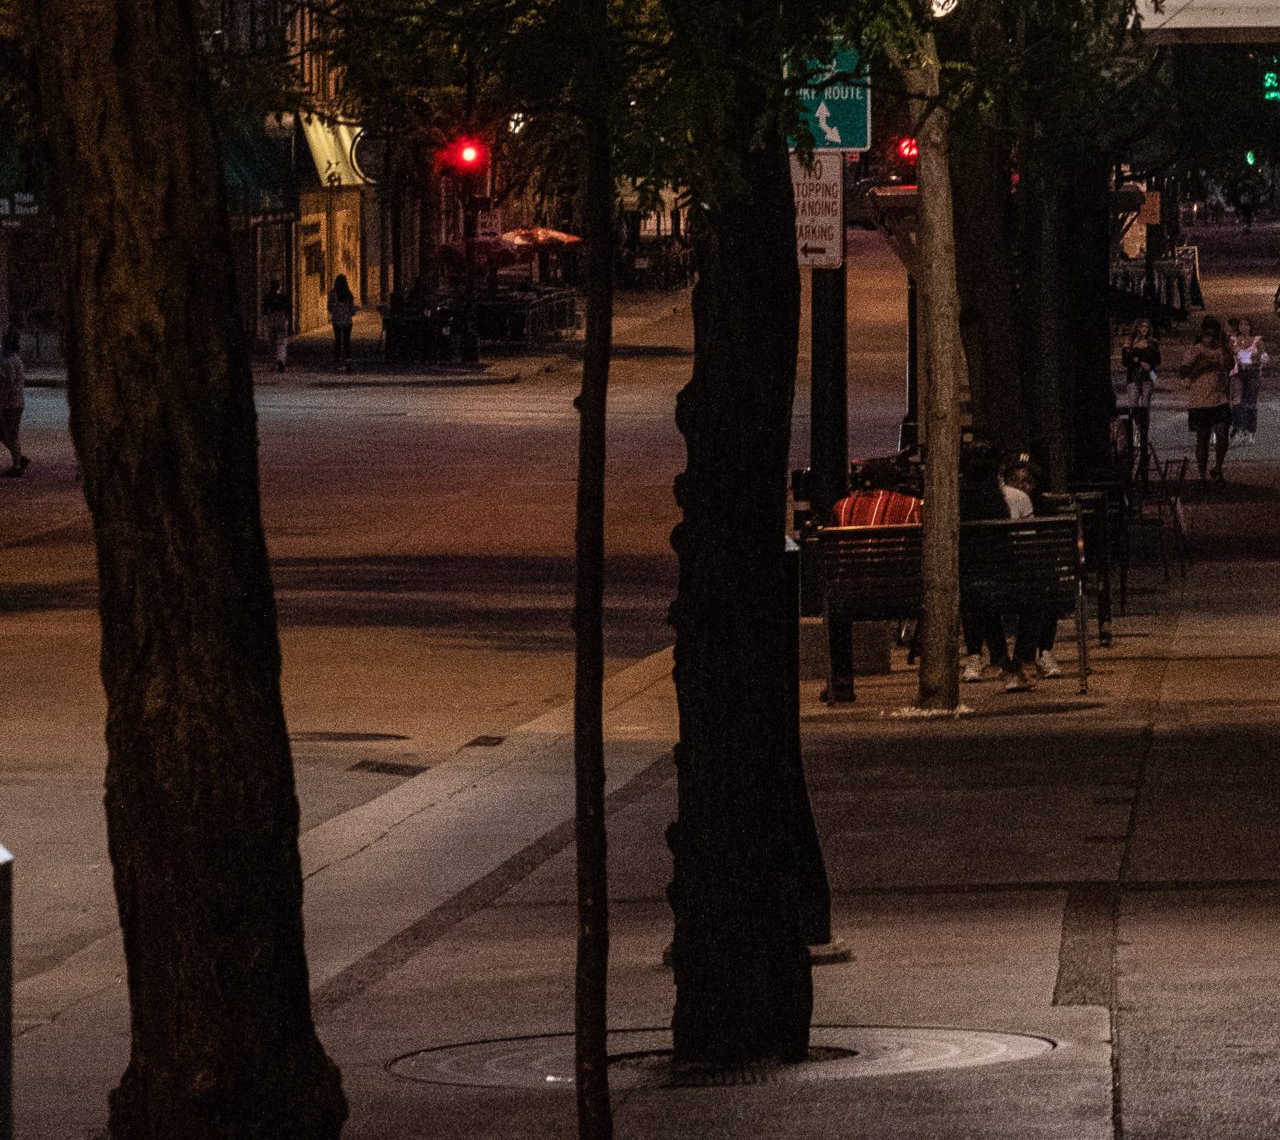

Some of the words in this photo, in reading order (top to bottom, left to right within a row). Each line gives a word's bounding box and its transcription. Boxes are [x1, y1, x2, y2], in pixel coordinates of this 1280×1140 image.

[824, 86, 864, 101] ROUTE
[796, 183, 839, 198] TOPPING
[796, 201, 838, 217] TANDING
[798, 225, 834, 241] ARKING
